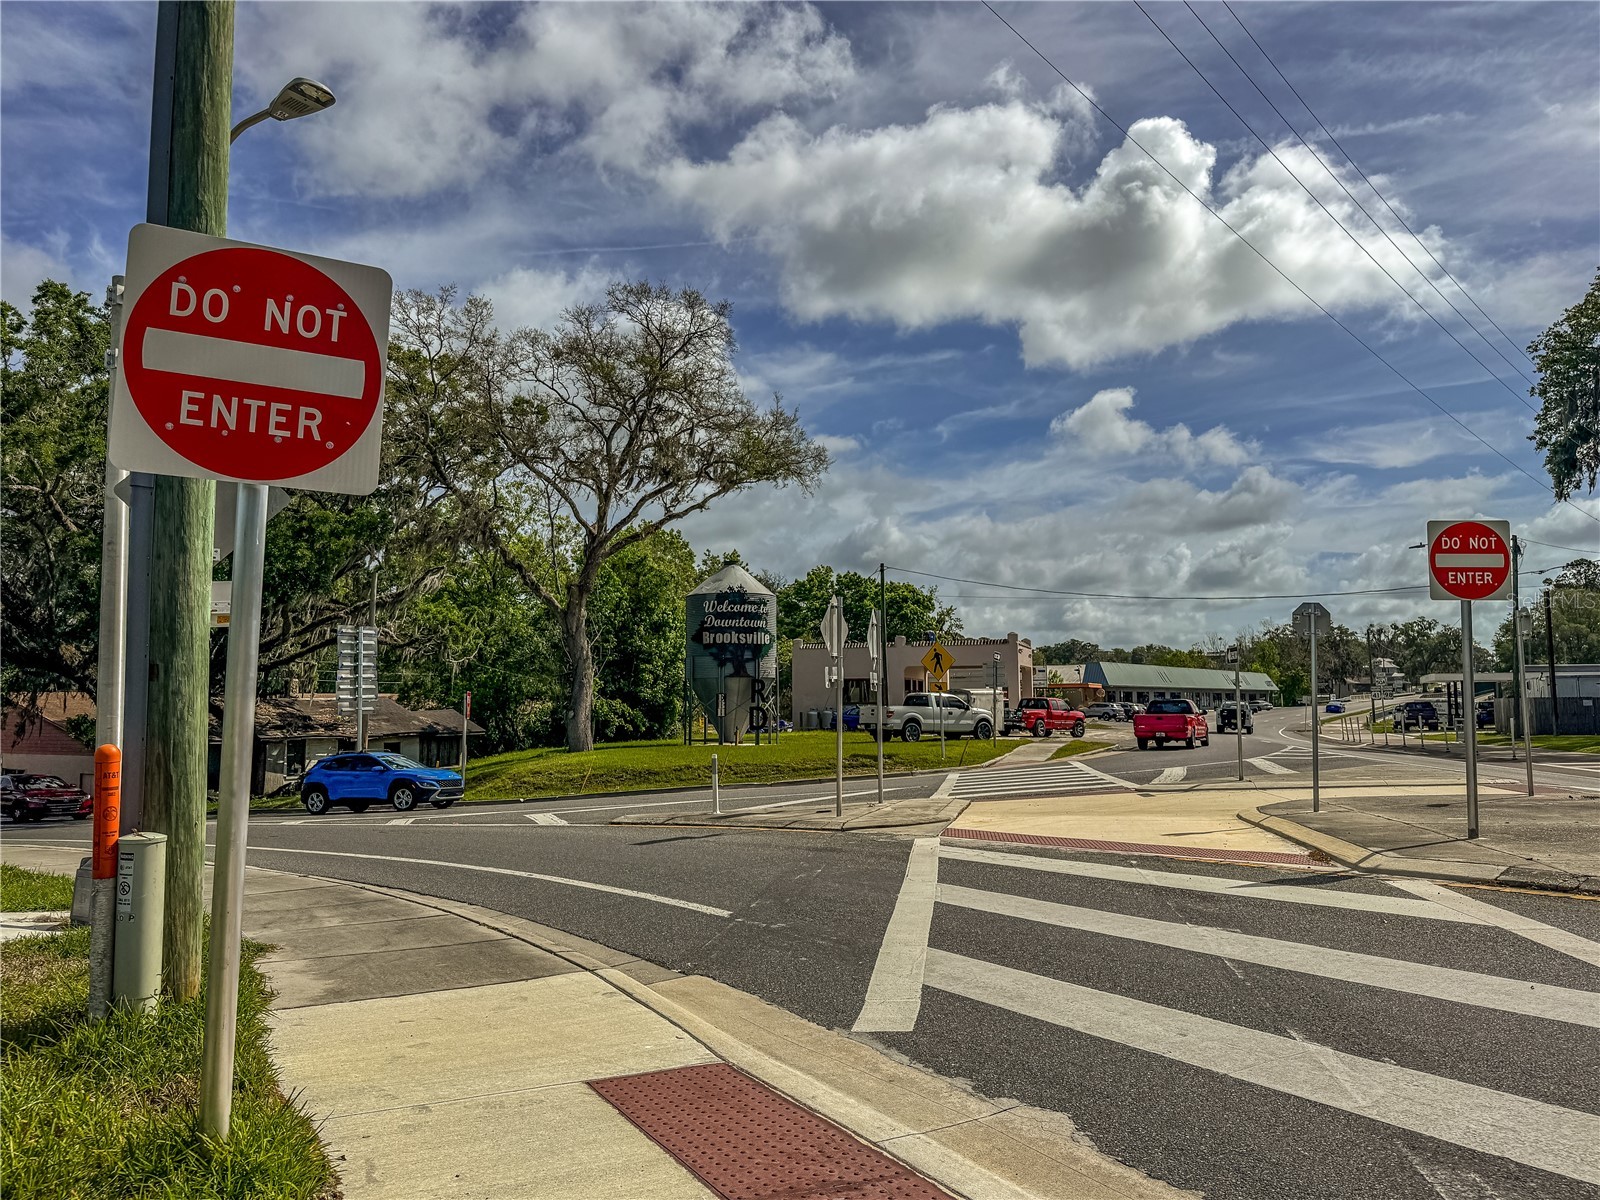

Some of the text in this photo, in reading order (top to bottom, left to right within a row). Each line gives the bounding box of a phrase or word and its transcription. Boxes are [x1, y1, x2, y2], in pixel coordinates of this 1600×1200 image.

[169, 281, 348, 342] DO NOT
[179, 390, 323, 441] ENTER
[1441, 537, 1497, 549] DO NOT
[1448, 572, 1493, 584] ENTER
[703, 600, 768, 614] Welcome to
[703, 614, 767, 628] Downtown
[702, 631, 770, 645] Brooksville
[103, 771, 119, 780] AT&T
